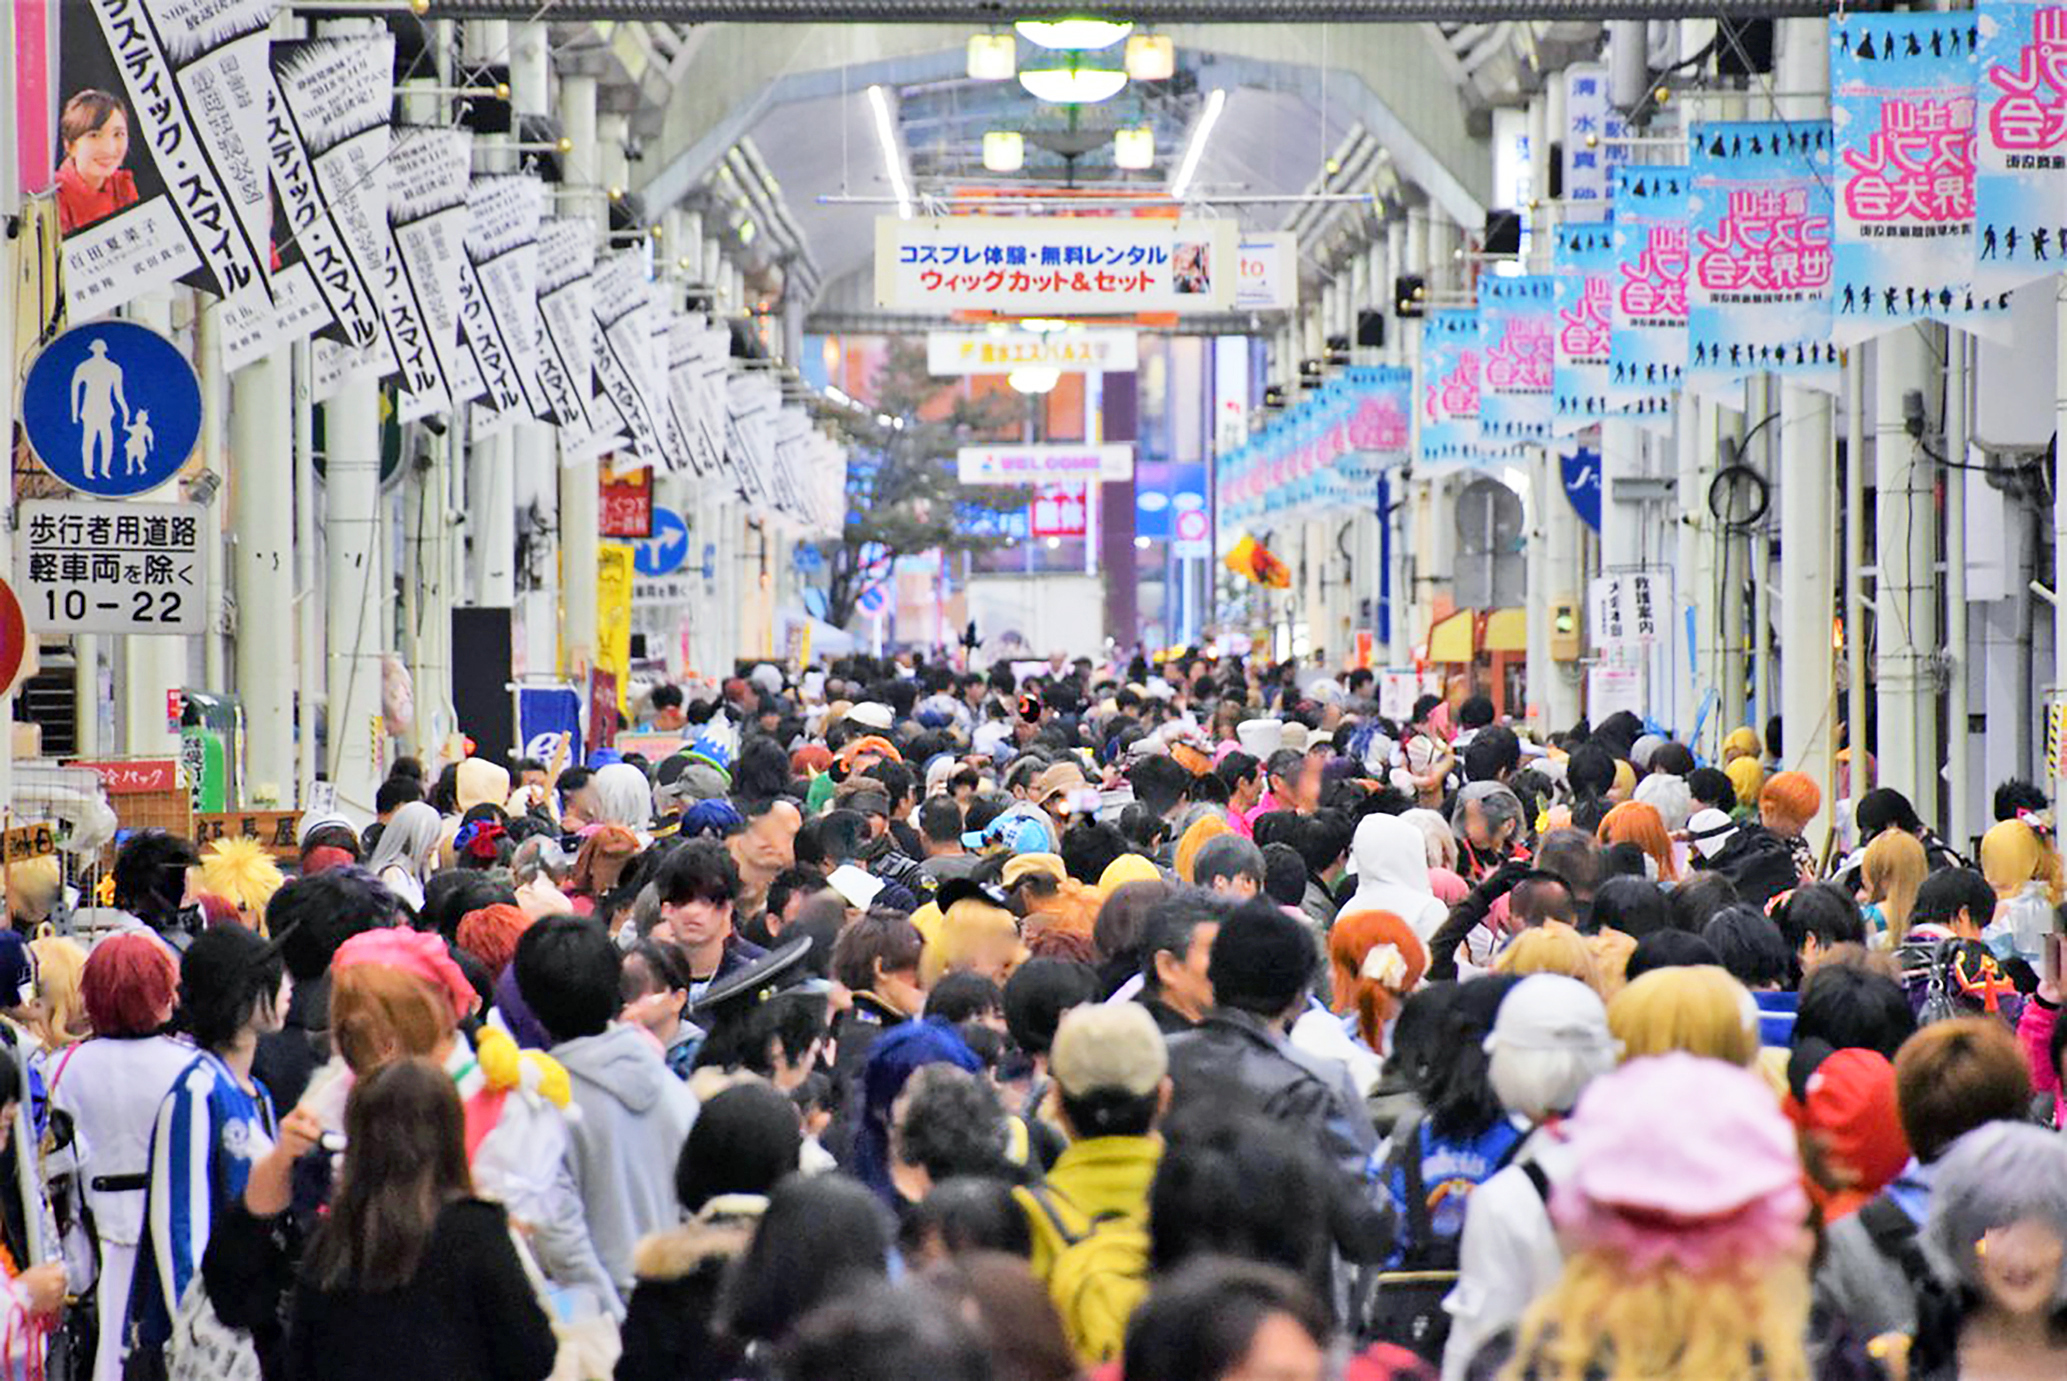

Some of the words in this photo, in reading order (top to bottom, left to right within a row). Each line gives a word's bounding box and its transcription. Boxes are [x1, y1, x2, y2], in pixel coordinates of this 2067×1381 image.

[268, 90, 374, 346] スティック・スマイル
[899, 245, 1168, 267] コスプレ体験・無料レンタル
[920, 269, 1156, 294] ウィッグカット&セット
[1001, 455, 1101, 470] WELCOME
[30, 515, 197, 547] 歩行者用道路
[28, 554, 194, 585] 軽車両を除く
